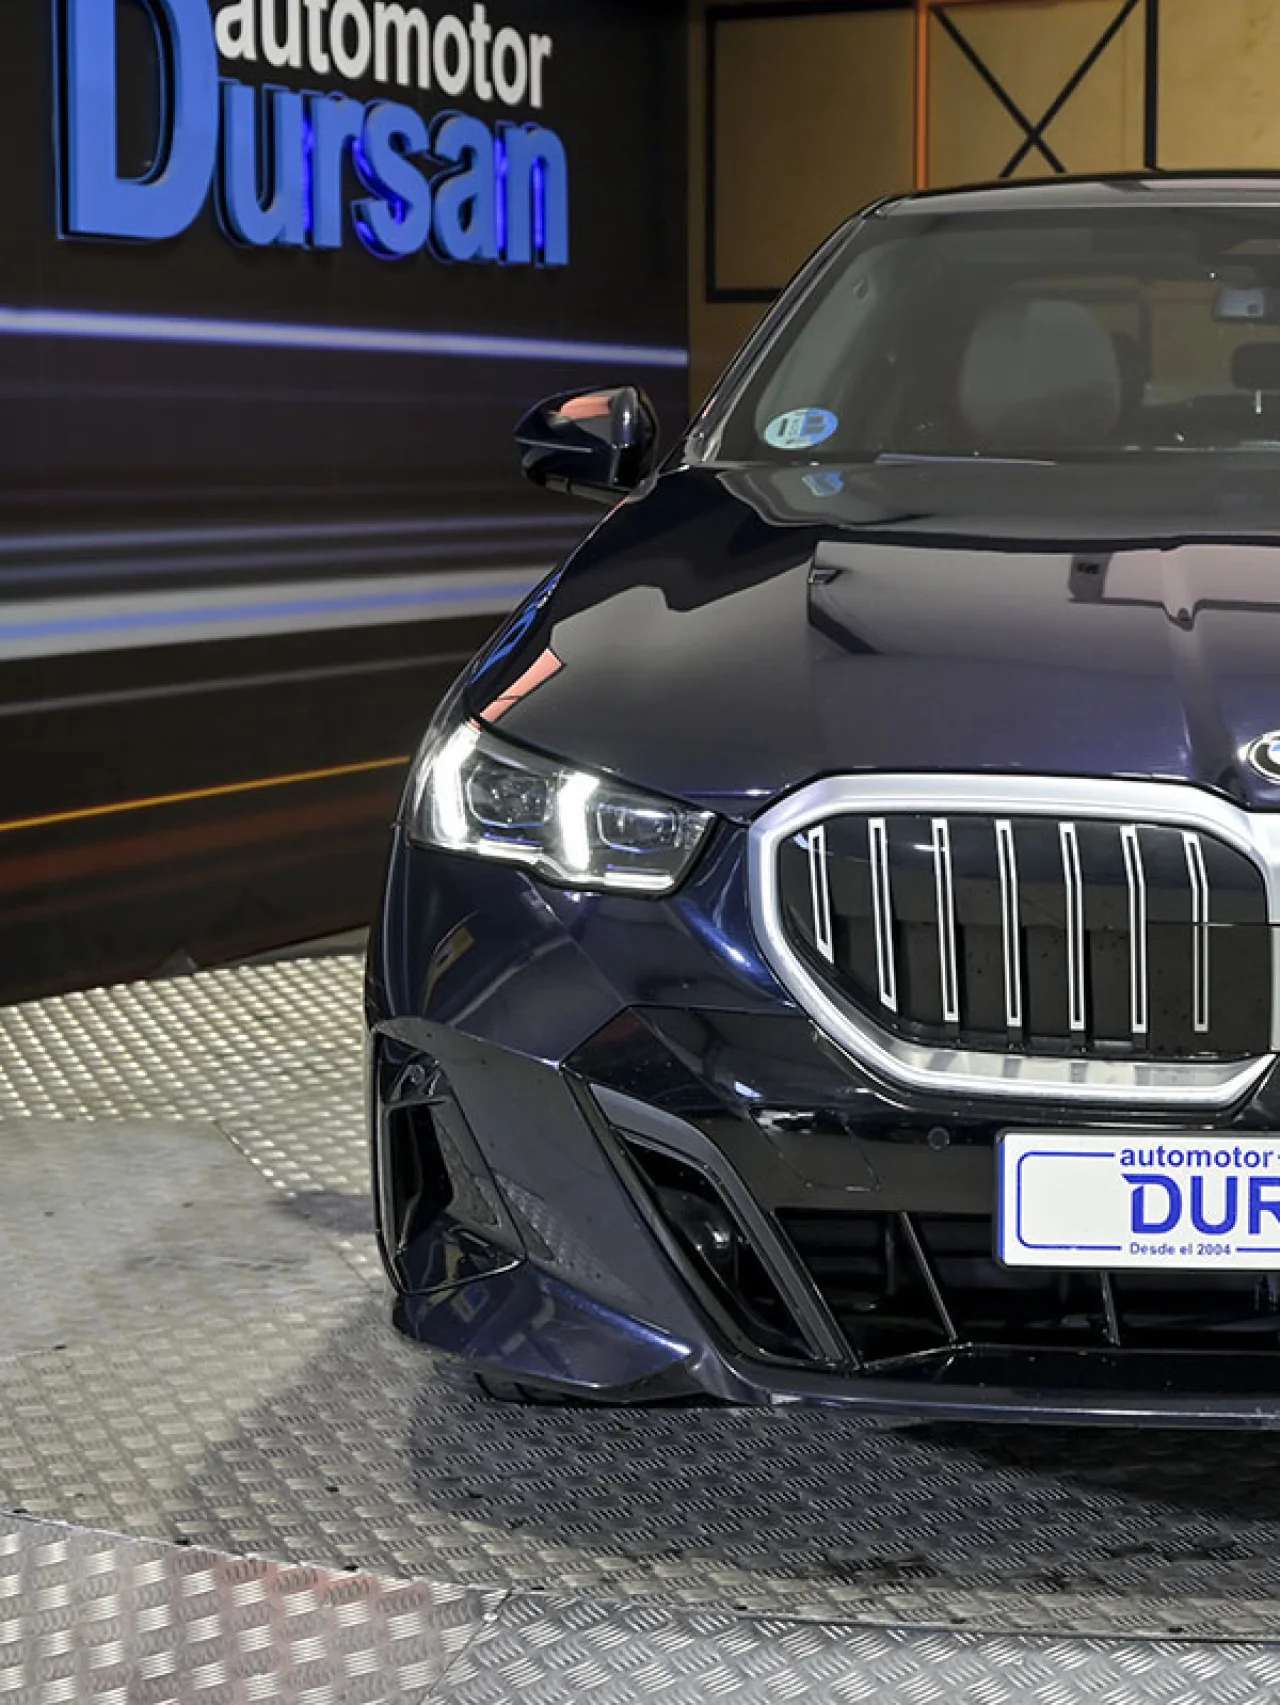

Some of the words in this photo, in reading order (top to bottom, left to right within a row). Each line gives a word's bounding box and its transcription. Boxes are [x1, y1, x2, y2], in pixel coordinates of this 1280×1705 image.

[215, 0, 552, 108] automotor
[54, 0, 570, 267] Dursan
[1120, 1146, 1274, 1168] automotor
[1130, 1242, 1176, 1255] Desde
[1179, 1243, 1193, 1255] el
[1197, 1243, 1231, 1255] 2004
